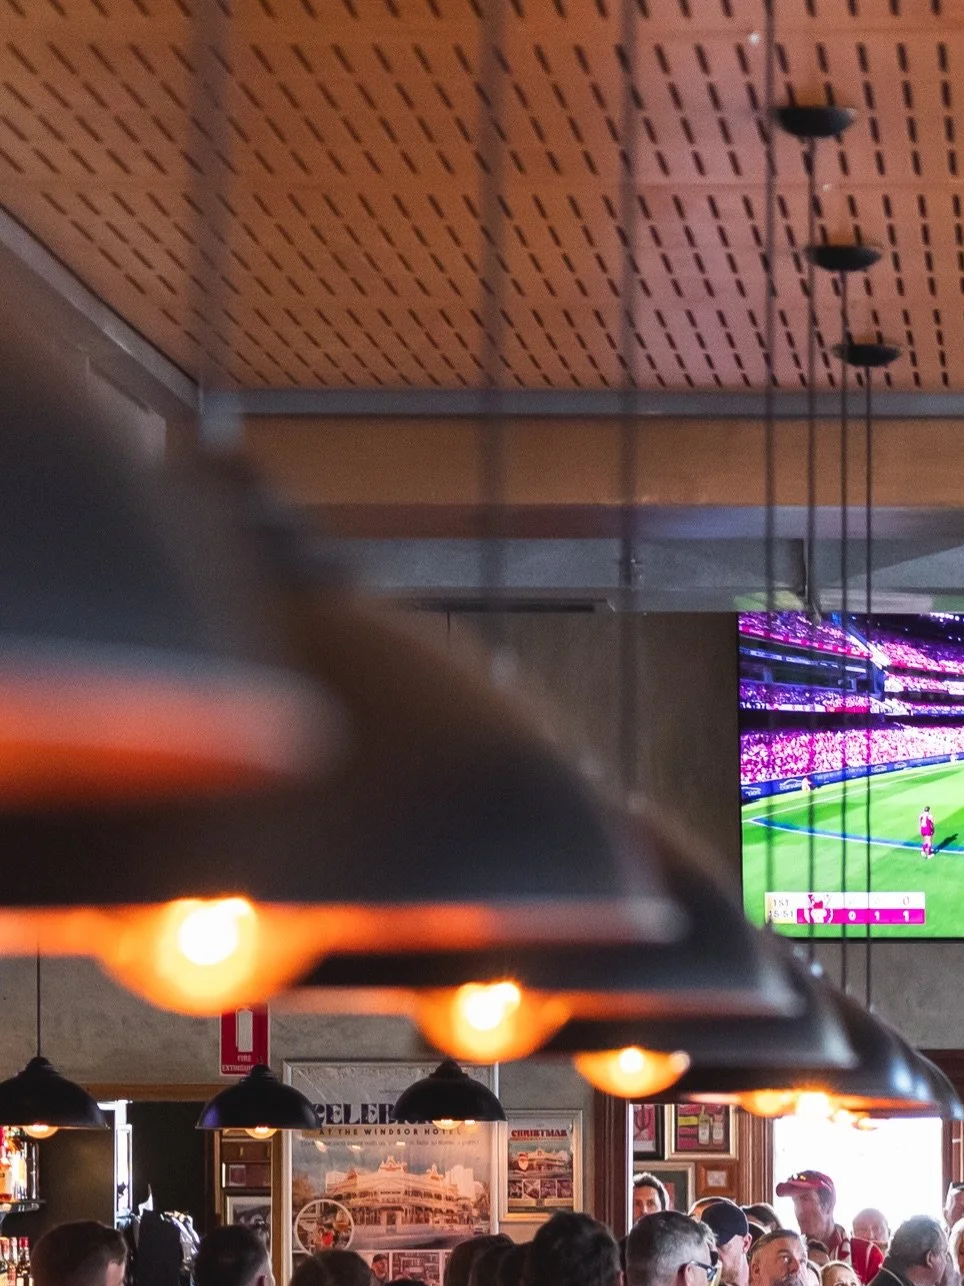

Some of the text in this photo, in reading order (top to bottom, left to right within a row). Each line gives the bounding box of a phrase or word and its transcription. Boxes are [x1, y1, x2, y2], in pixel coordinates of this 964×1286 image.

[320, 1128, 462, 1136] AT THE WINDSOR HOTEL
